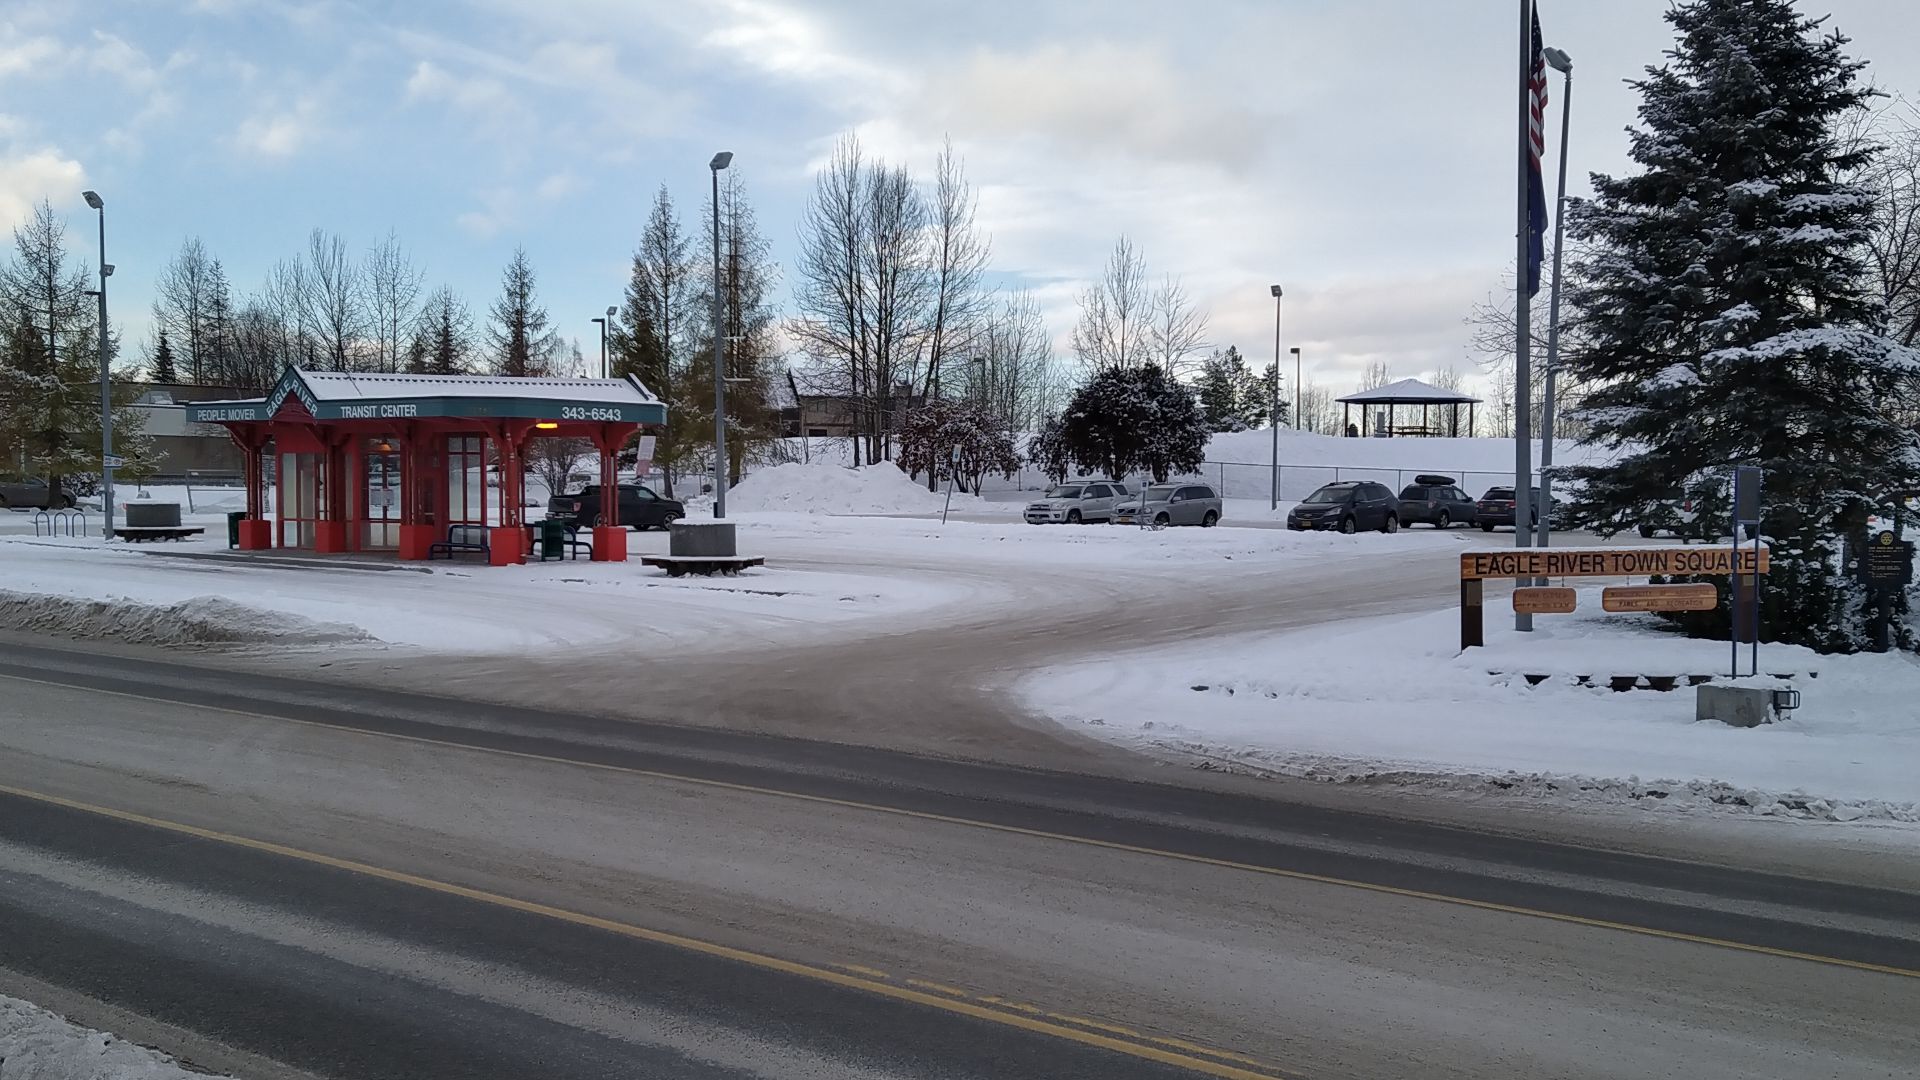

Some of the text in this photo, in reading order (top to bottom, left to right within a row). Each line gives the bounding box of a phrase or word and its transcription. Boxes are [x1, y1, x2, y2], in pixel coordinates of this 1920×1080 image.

[266, 379, 318, 417] EAGLE RIVER
[198, 409, 255, 421] PEOPLE MOVER
[340, 404, 417, 418] TRANSIT CENTER
[562, 406, 621, 421] 343-6543
[1475, 551, 1757, 575] EAGLE RIVER TOWN SQUARE
